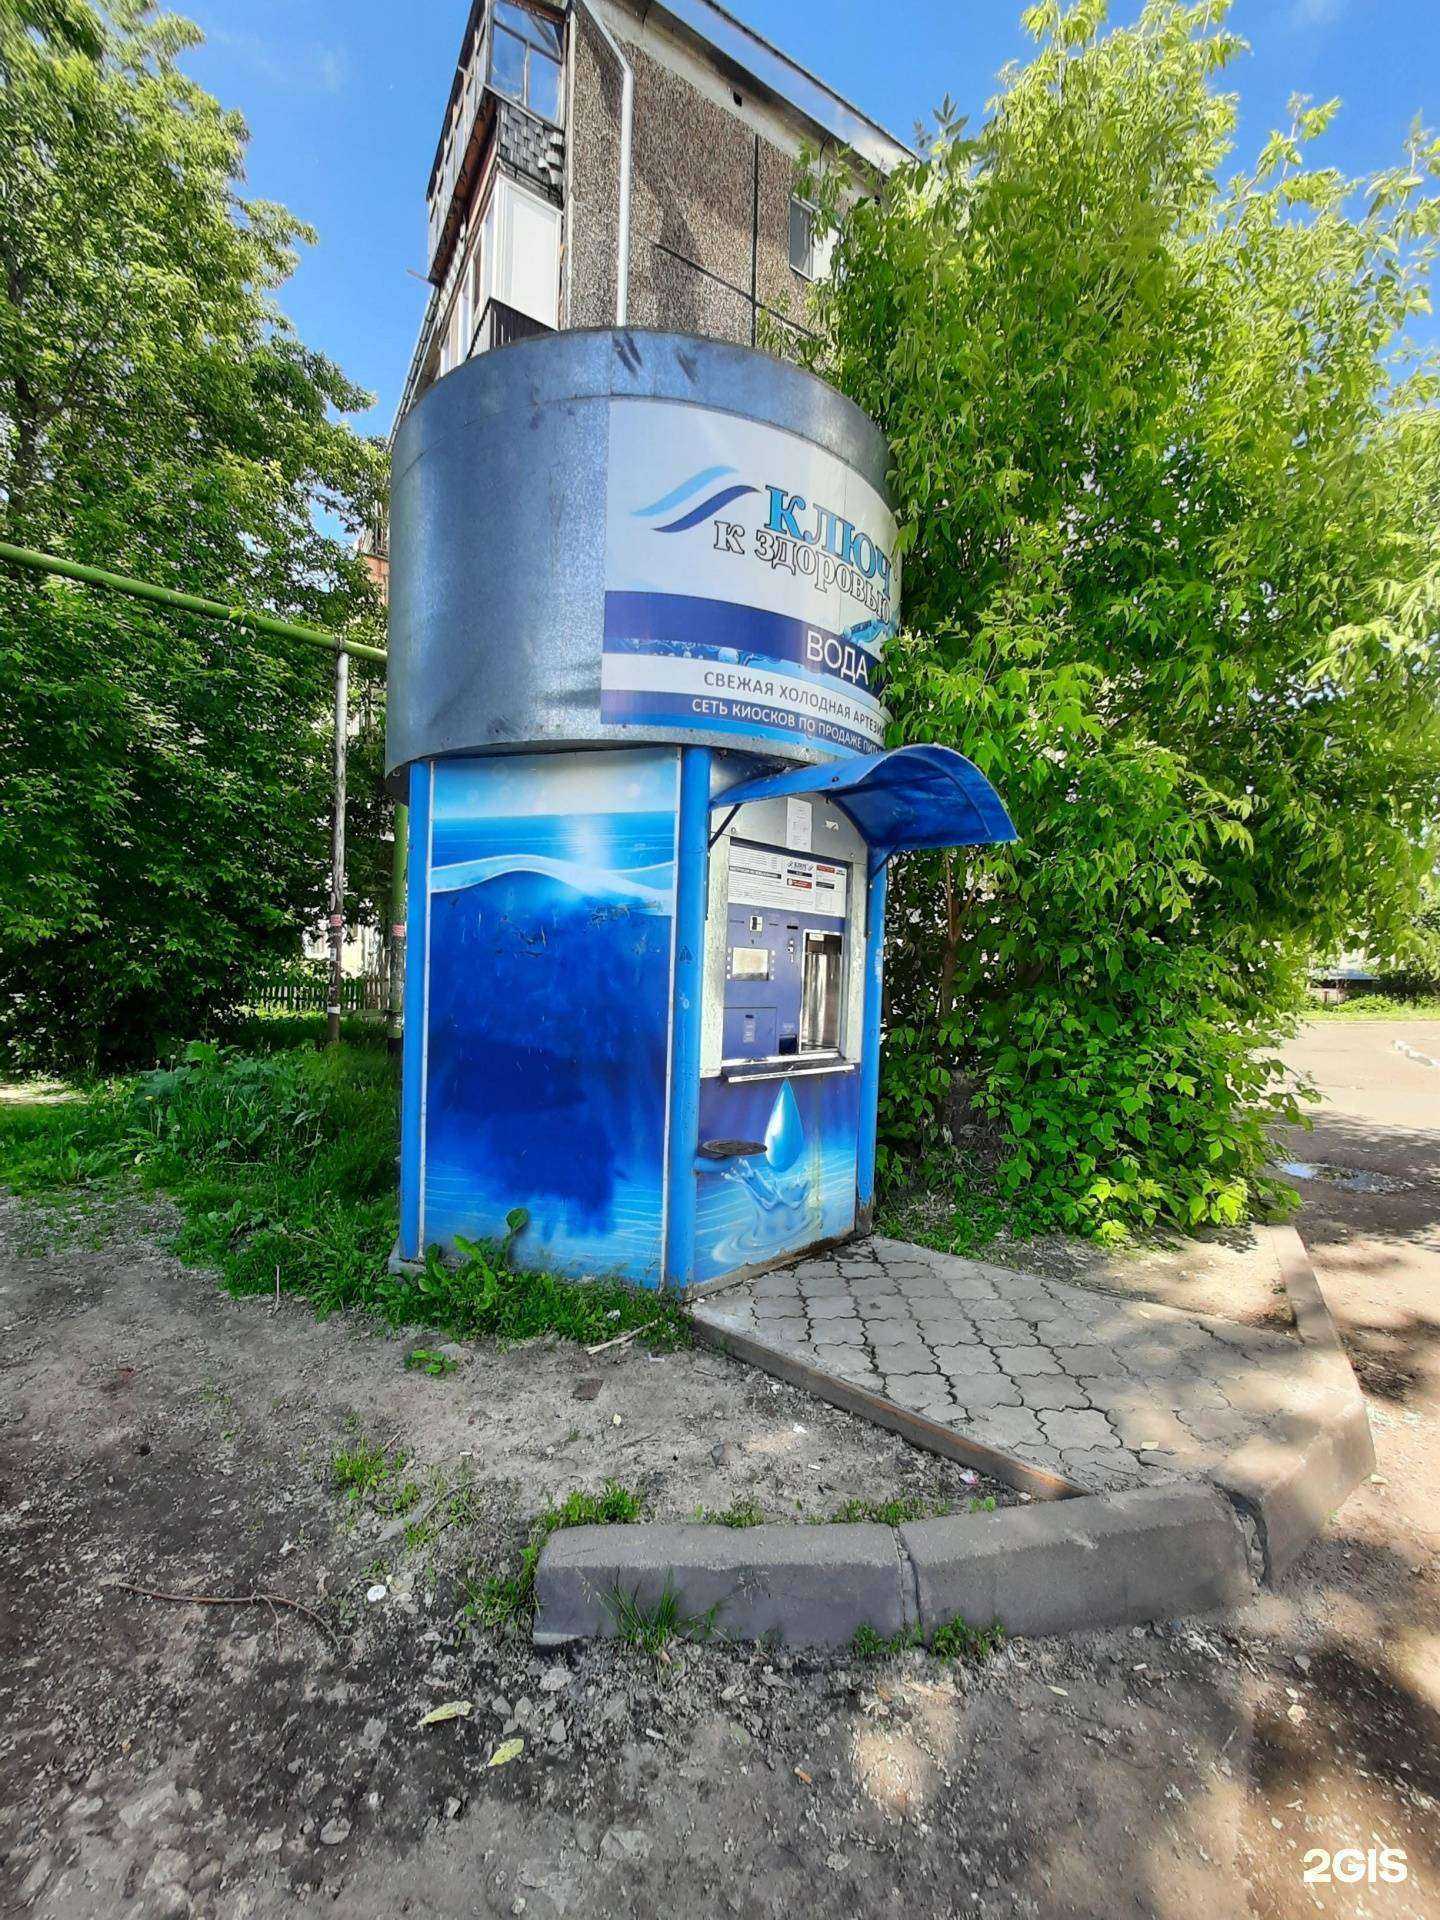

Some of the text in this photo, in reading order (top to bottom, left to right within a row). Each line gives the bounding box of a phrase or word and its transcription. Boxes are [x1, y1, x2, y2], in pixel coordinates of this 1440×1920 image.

[806, 630, 869, 686] ВОДА
[703, 671, 774, 696] СВЕЖАЯ
[779, 684, 852, 720] ХОЛОДНАЯ
[692, 698, 728, 715] СЕТЬ
[732, 703, 796, 727] КИОСКОВ
[798, 717, 816, 732] ПО
[818, 722, 862, 750] ПРОДАЖЕ
